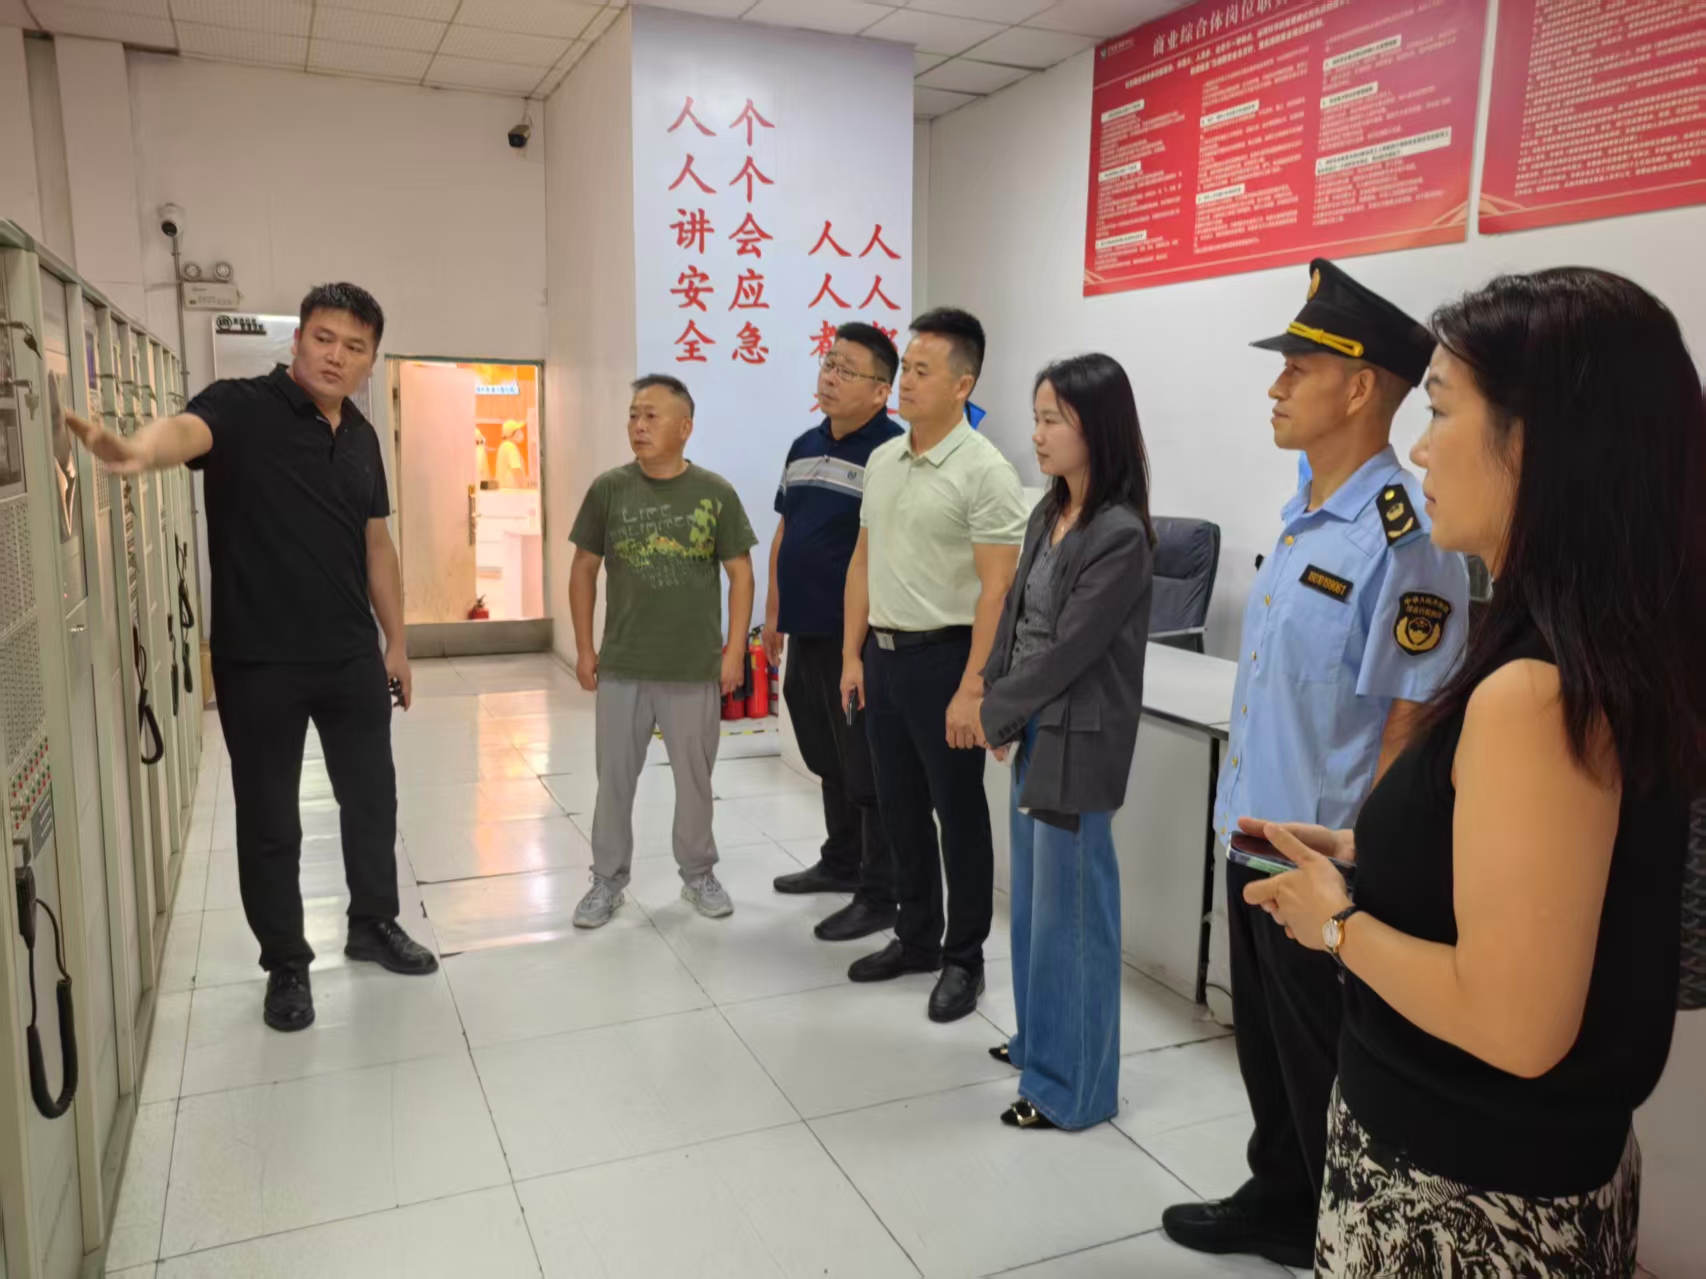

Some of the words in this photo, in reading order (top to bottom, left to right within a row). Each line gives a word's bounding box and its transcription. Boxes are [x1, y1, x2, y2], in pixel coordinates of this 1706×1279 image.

[667, 96, 718, 364] 人人讲安全
[727, 98, 776, 365] 个个会应急
